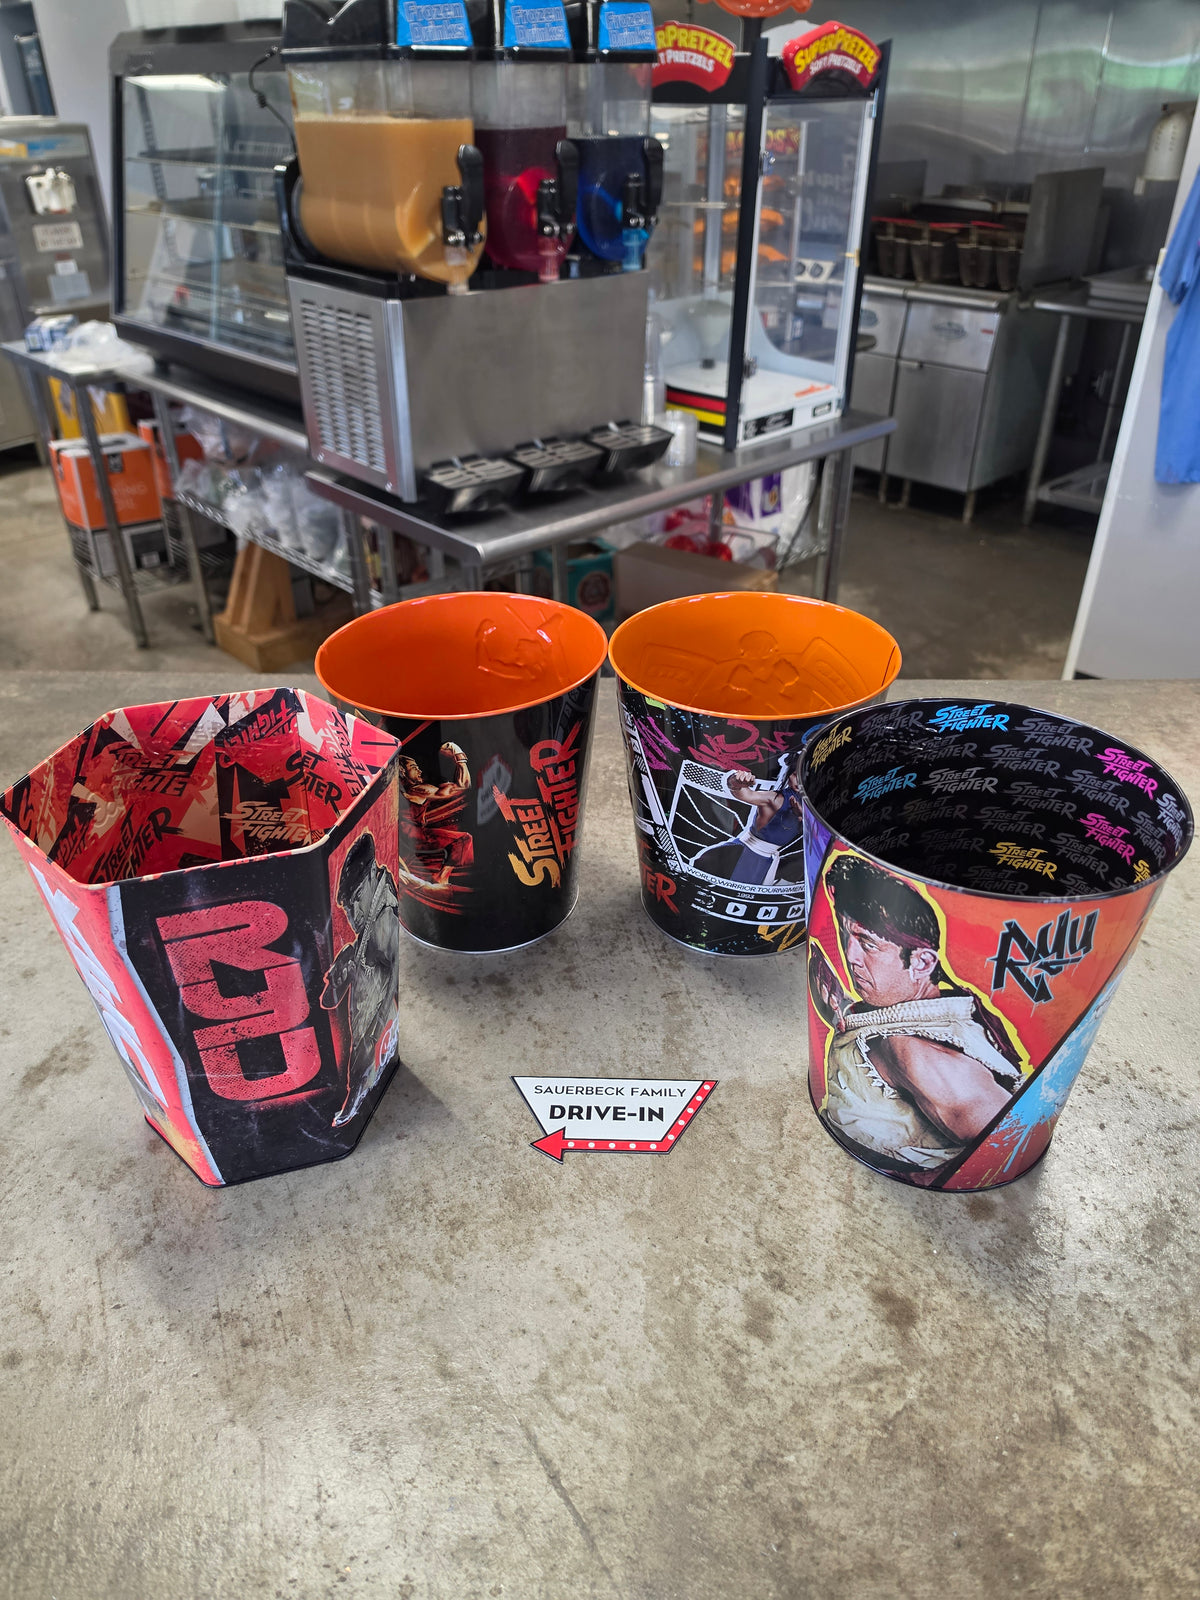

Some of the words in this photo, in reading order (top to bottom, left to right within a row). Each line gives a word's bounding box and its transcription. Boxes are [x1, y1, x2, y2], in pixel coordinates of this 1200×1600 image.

[405, 1, 464, 21] Frozen
[511, 6, 565, 24] Frozen
[926, 703, 997, 725] STREET
[937, 712, 1010, 734] FIGHTER
[1012, 717, 1080, 735] STREET
[911, 742, 978, 764] FIGHTER
[980, 743, 1049, 760] STREET
[1023, 730, 1095, 757] FIGHTER
[991, 757, 1061, 779] FIGHTER
[1092, 747, 1154, 773] STREET
[853, 765, 905, 799] STREET
[920, 767, 986, 785] STREET
[930, 776, 999, 794] FIGHTER
[1062, 769, 1122, 790] STREET
[1101, 760, 1159, 800] FIGHTER
[529, 720, 583, 869] FIGHTER
[860, 772, 918, 805] FIGHTER
[1001, 781, 1067, 799] STREET
[1071, 781, 1131, 817] FIGHTER
[220, 801, 309, 823] STREET
[971, 806, 1035, 822] STREET
[1009, 794, 1078, 820] FIGHTER
[491, 783, 562, 889] STREET
[980, 819, 1047, 840] FIGHTER
[1076, 812, 1131, 838] STREET
[1130, 811, 1166, 841] STREET
[986, 842, 1049, 860] STREET
[1047, 832, 1103, 856] STREET
[1083, 825, 1136, 866] FIGHTER
[1133, 825, 1167, 868] FIGHTER
[993, 853, 1058, 881] FIGHTER
[1055, 844, 1110, 881] FIGHTER
[686, 865, 718, 886] WORLD
[717, 879, 759, 895] WARRIOR
[757, 883, 806, 895] TOURNAMEN
[533, 1085, 625, 1097] SAUERBECK
[630, 1087, 687, 1098] FAMILY
[549, 1104, 665, 1122] DRIVE-IN
